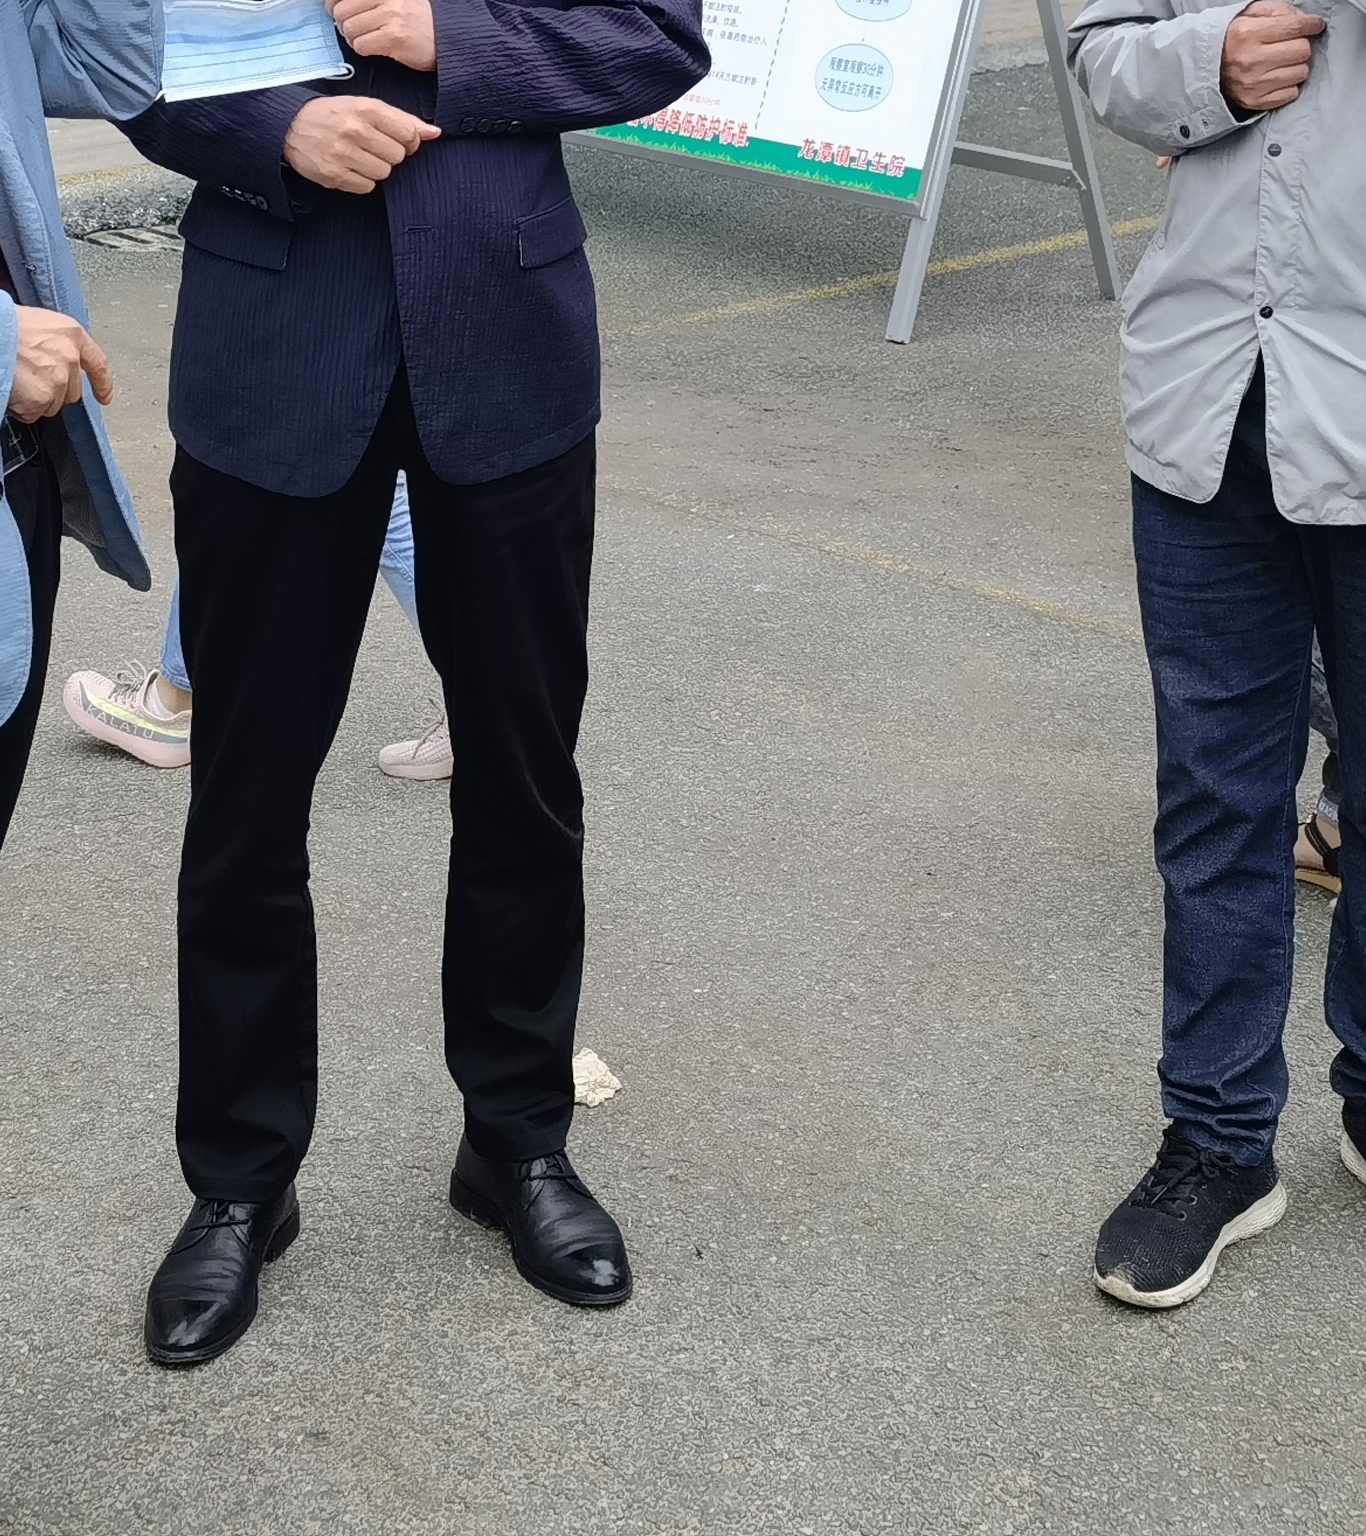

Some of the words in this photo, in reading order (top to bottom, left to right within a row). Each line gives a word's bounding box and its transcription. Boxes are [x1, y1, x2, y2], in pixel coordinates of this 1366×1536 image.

[828, 56, 884, 78] 观察室观察30分钟
[799, 137, 906, 177] 龙潭镇卫生院
